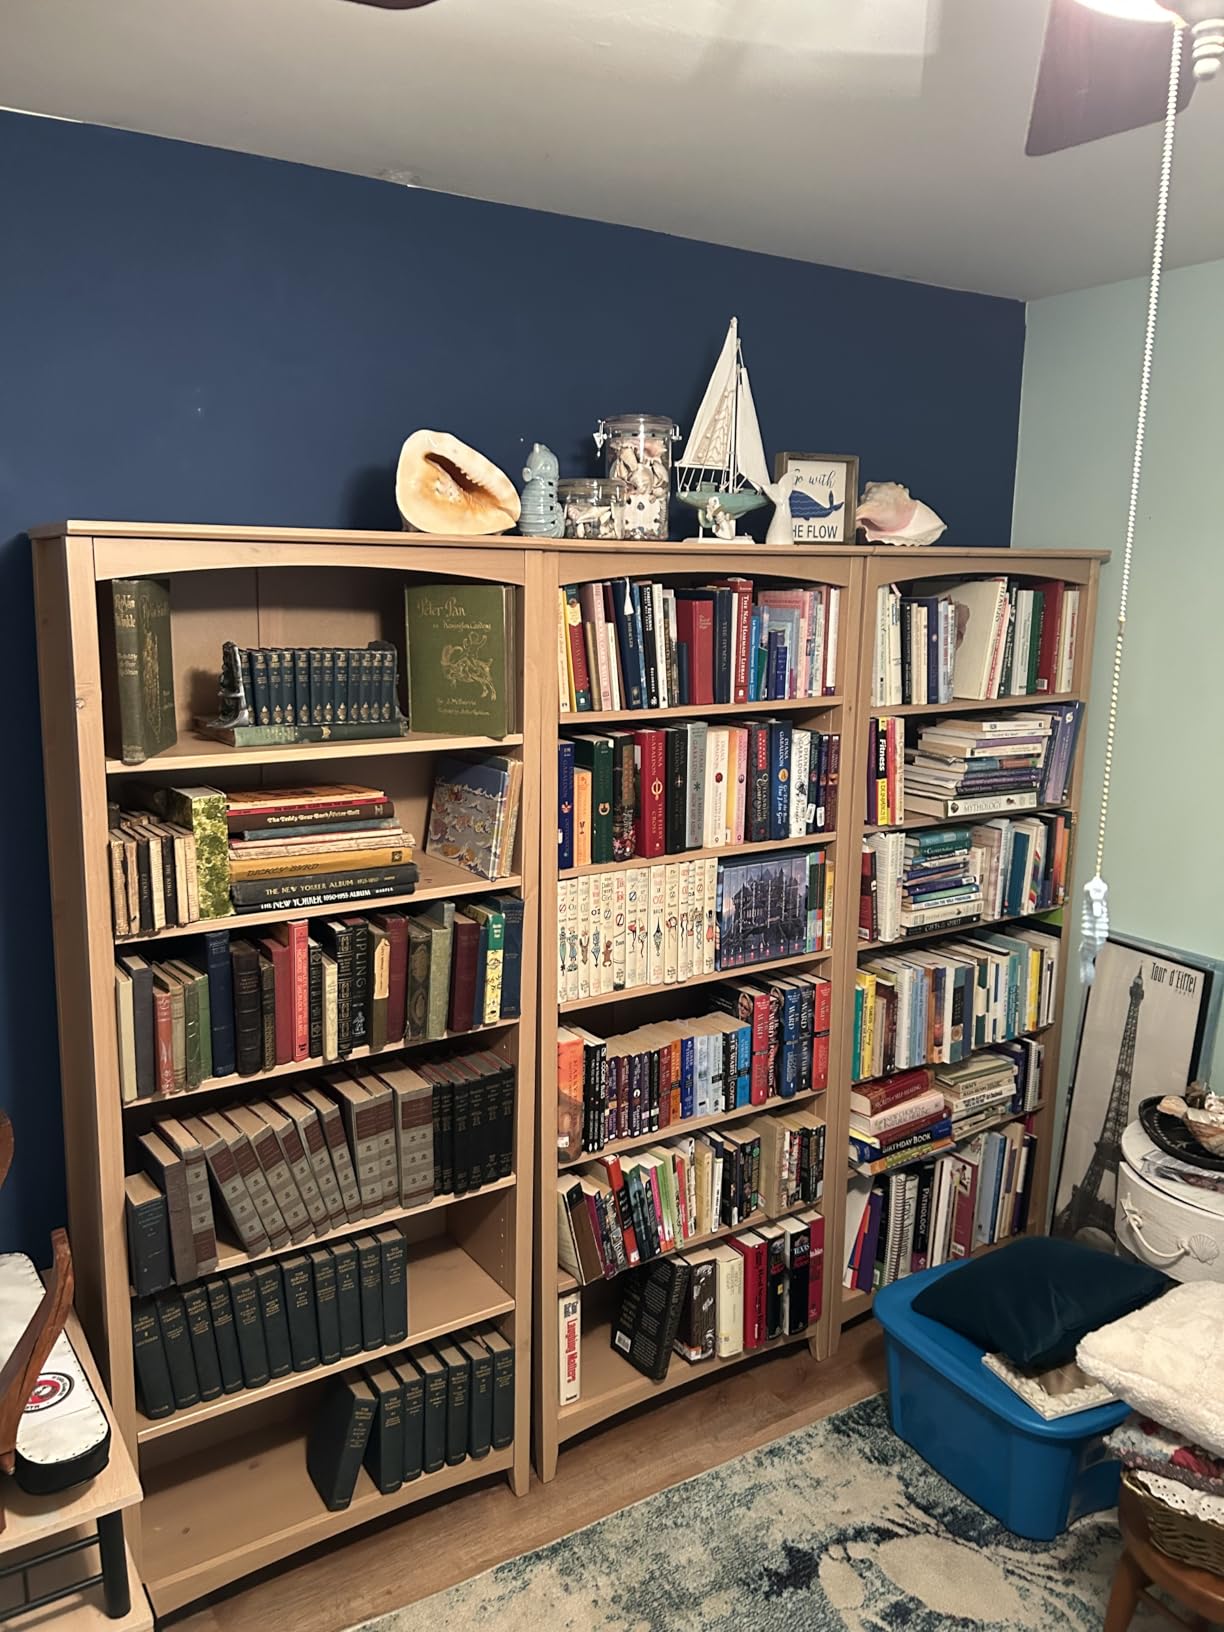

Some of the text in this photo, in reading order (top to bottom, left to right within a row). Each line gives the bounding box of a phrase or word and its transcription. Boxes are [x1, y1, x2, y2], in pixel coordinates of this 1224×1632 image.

[809, 470, 836, 488] with
[792, 525, 838, 538] HE FLOW
[416, 597, 467, 618] Peter Pan
[964, 801, 1001, 812] MYTHOLOGY
[267, 816, 279, 824] The
[280, 814, 298, 823] Teddy
[298, 813, 314, 822] Bear
[266, 888, 279, 896] THE
[281, 885, 297, 894] NEW
[299, 882, 328, 891] YORKER
[329, 880, 354, 889] ALBUM
[272, 899, 291, 910] NEW
[292, 895, 323, 907] YORKER
[350, 890, 371, 899] ALBUM
[946, 919, 961, 927] SPIRIT
[355, 927, 367, 988] KIPLING
[1151, 962, 1197, 993] Tour d'Eiffel
[800, 1002, 808, 1029] WARD
[882, 1132, 931, 1154] BIRTHDAY BOOK
[919, 1188, 930, 1234] PATHOLOGY
[794, 1244, 810, 1255] TEXAS
[902, 1223, 913, 1256] Anatomy
[672, 1267, 683, 1304] SCHWAB
[566, 1318, 578, 1354] Laughing
[566, 1353, 577, 1383] Matters
